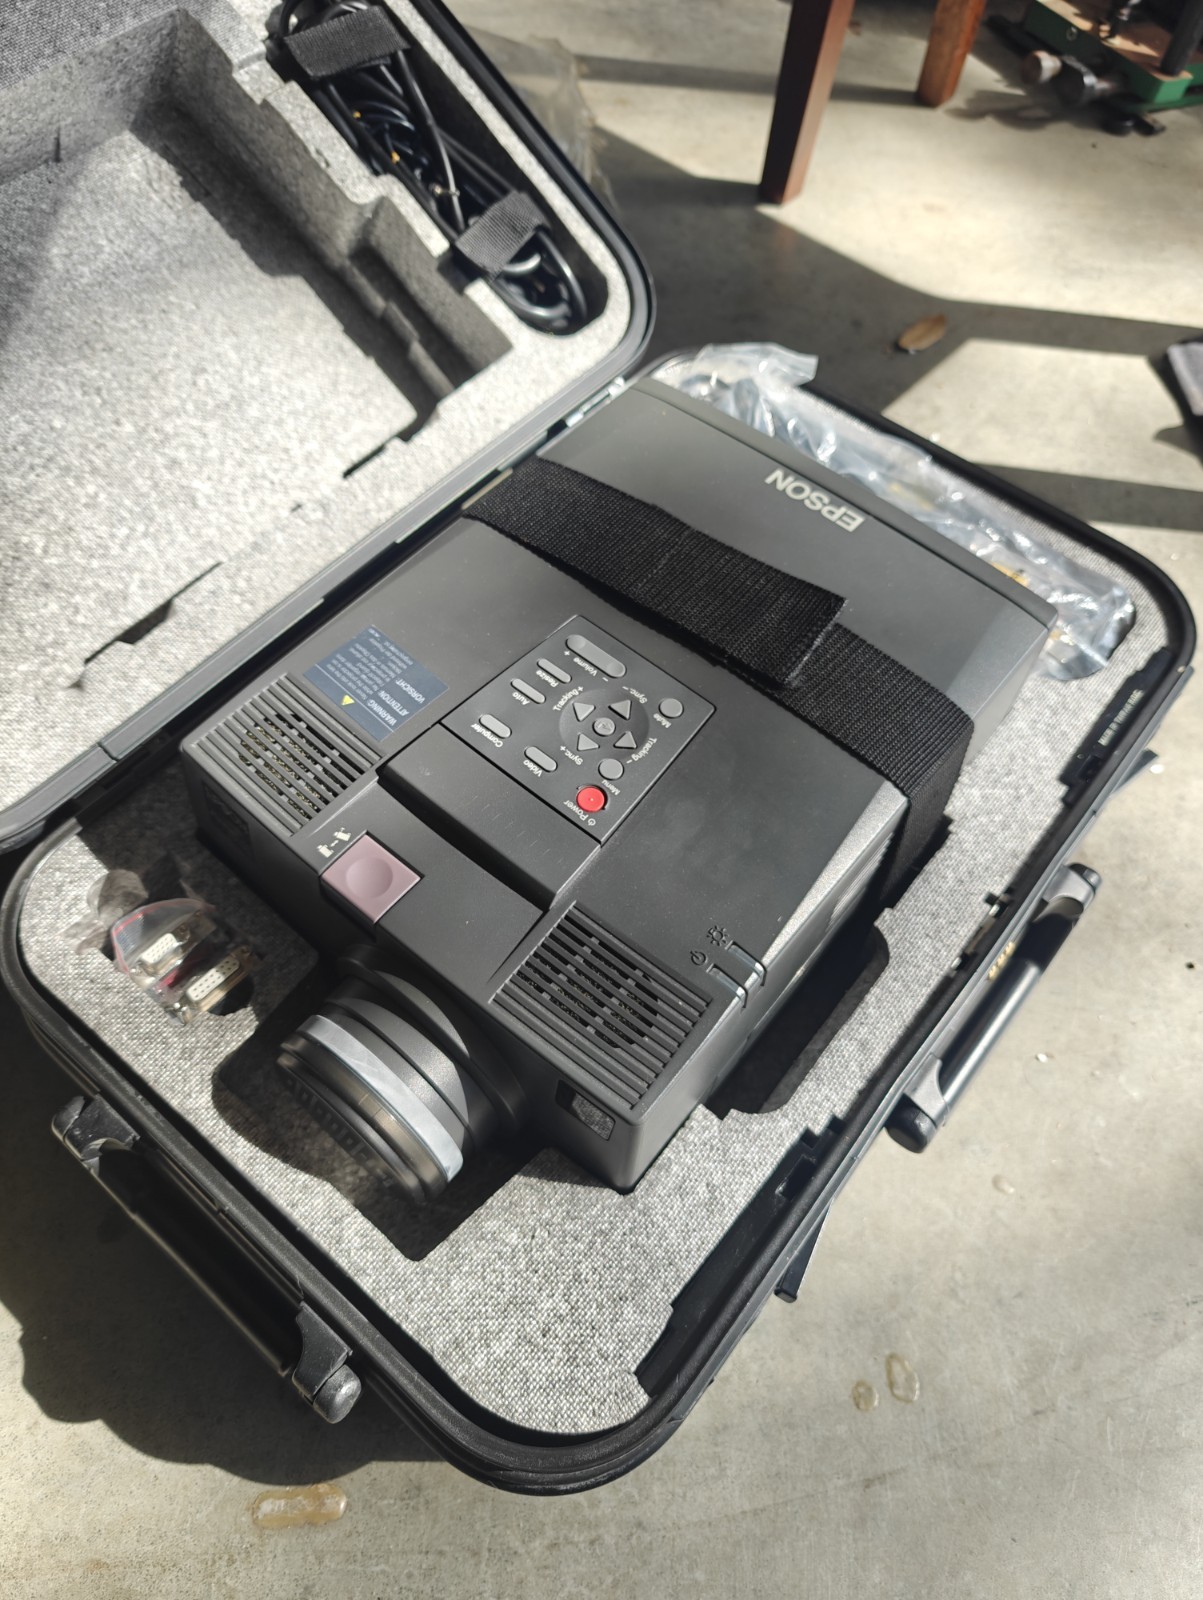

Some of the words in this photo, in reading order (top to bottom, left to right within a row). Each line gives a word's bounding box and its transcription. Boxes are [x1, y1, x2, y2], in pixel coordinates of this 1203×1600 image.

[764, 468, 865, 533] EPSON
[573, 657, 598, 677] Volume
[535, 669, 560, 688] Resize
[512, 691, 530, 706] Auto
[552, 689, 579, 711] Tracking
[629, 688, 648, 704] Sync.
[653, 712, 672, 728] Mute
[470, 723, 504, 748] Computer
[631, 737, 657, 762] Tracking
[523, 759, 543, 777] Video
[601, 779, 621, 796] Menu
[563, 800, 589, 821] Power
